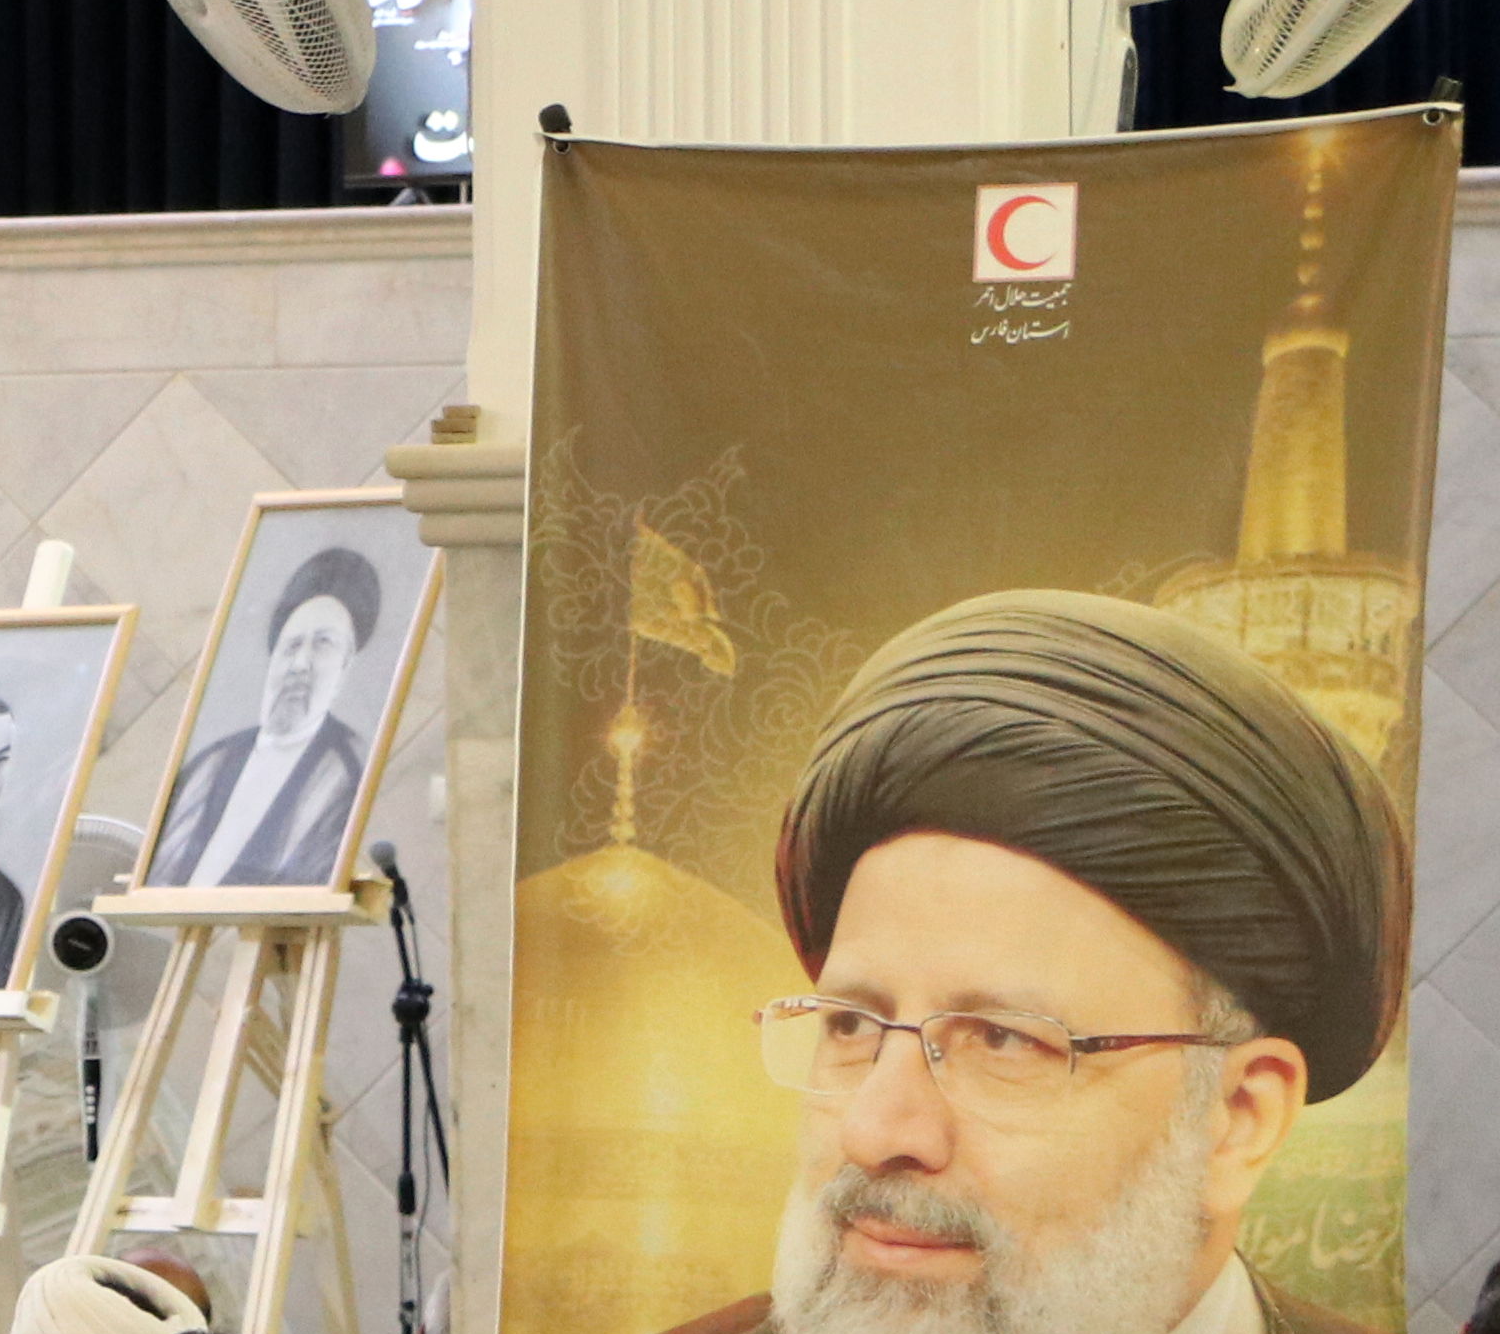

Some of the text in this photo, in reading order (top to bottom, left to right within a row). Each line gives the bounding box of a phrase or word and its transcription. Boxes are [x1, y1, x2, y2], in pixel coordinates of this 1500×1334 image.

[994, 284, 1028, 312] هلال
[970, 318, 1071, 345] استان فارس
